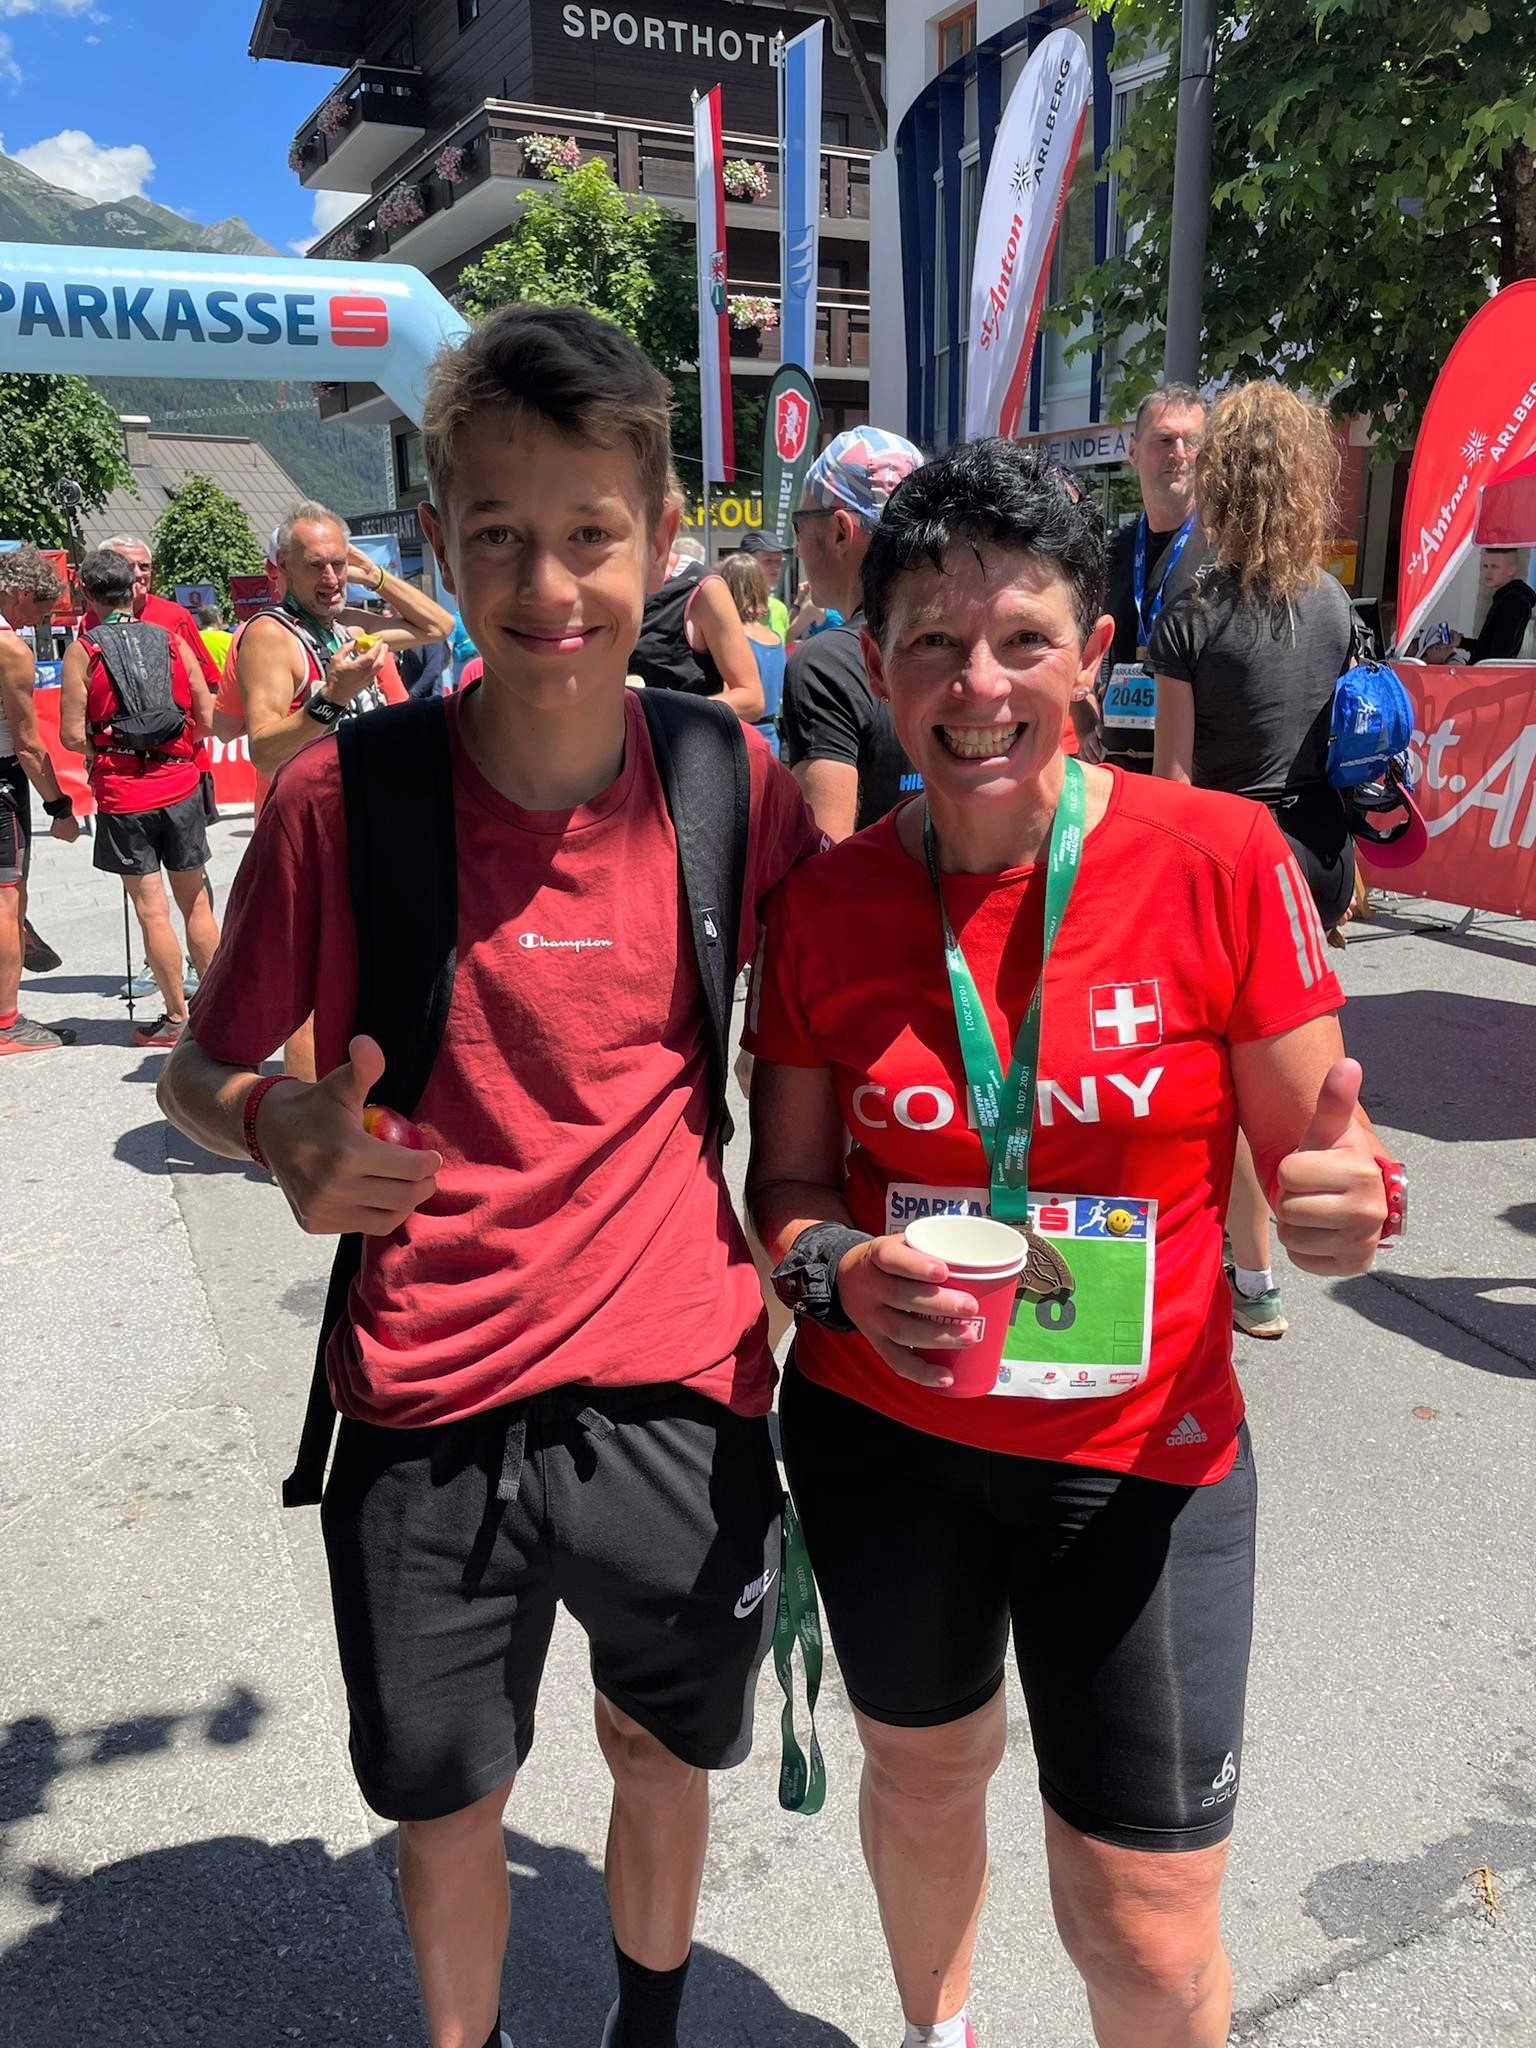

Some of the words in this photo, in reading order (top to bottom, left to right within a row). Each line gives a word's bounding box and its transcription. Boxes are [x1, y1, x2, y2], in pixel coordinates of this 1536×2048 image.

[1033, 57, 1072, 187] ARLBERG
[988, 212, 1025, 341] Anton
[1049, 432, 1137, 461] EINDEA
[1111, 687, 1155, 707] 2045
[518, 932, 614, 953] Champion
[958, 984, 975, 1031] 10.07.2021
[972, 1085, 989, 1127] MARATHON
[1015, 1065, 1031, 1115] 10.07.2021
[1016, 1128, 1028, 1171] MARATHON
[1166, 1432, 1208, 1446] adidas
[742, 1569, 770, 1604] NIKE
